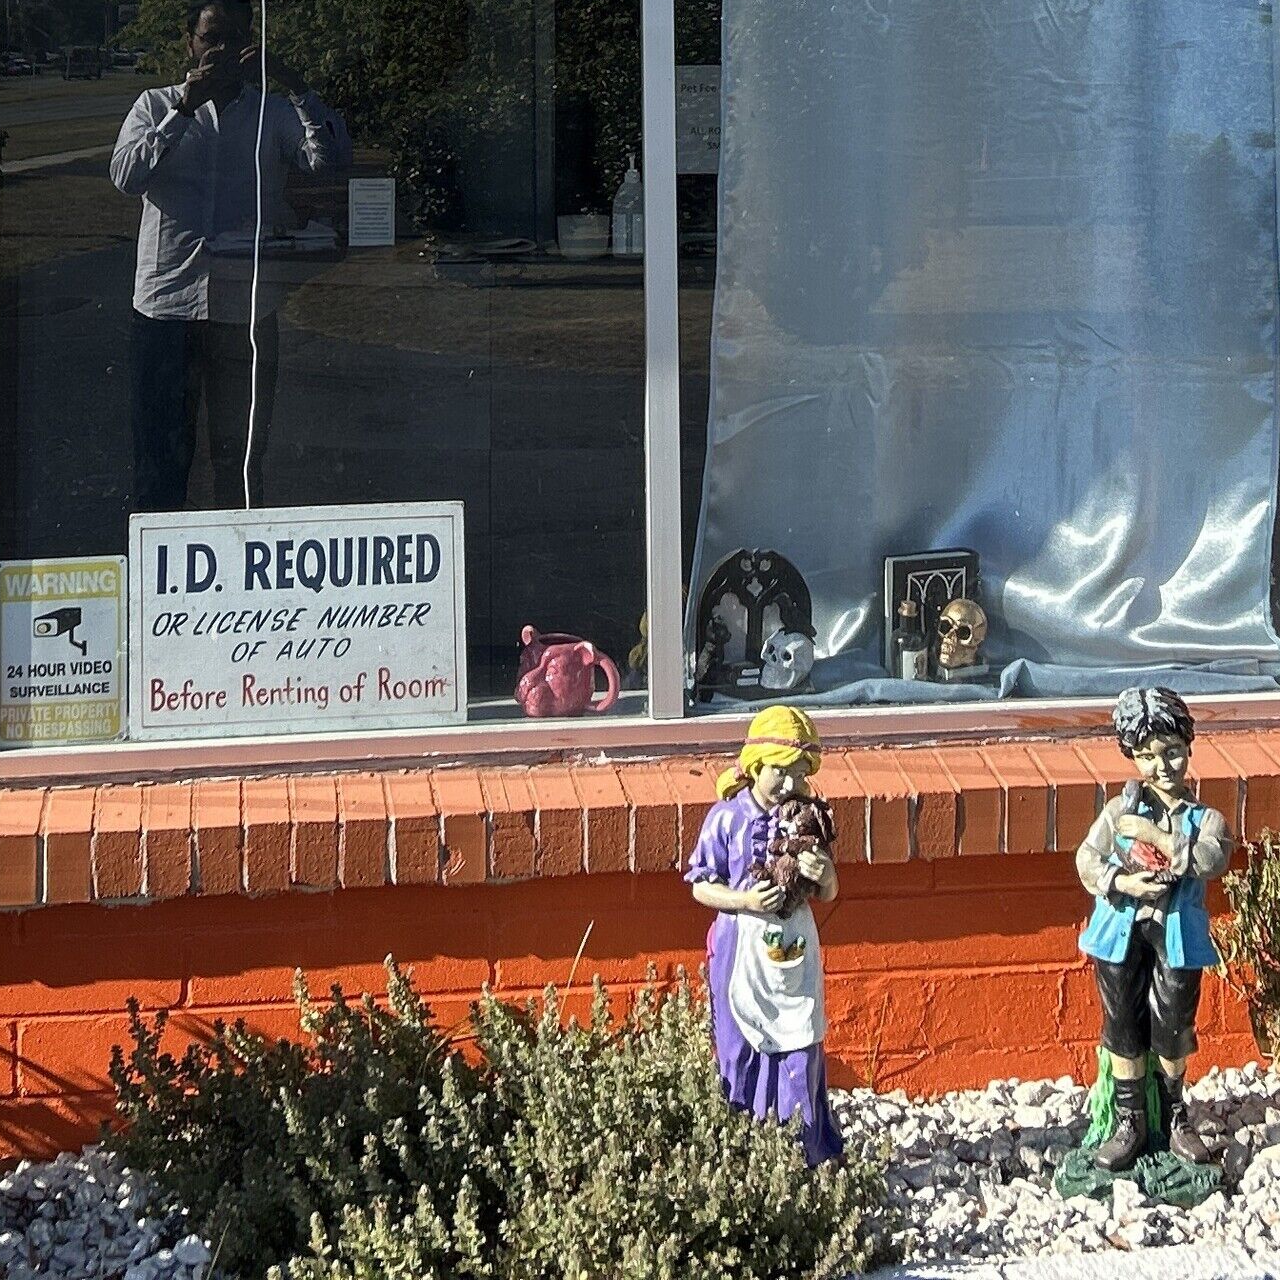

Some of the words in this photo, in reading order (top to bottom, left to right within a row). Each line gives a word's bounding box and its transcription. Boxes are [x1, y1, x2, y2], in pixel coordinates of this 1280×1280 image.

[156, 543, 223, 595] I.D.
[244, 533, 441, 593] REQUIRED
[4, 570, 116, 597] WARNING
[151, 612, 188, 637] OR
[192, 607, 307, 635] LICENSE
[317, 602, 432, 630] NUMBER
[230, 640, 267, 663] OF
[275, 637, 351, 662] AUTO
[7, 665, 23, 679] 24
[27, 662, 66, 677] HOUR
[70, 660, 112, 675] VIDEO
[9, 681, 110, 698] SURVEILLANCE
[150, 677, 227, 713] Before
[242, 673, 329, 710] Renting
[339, 671, 367, 703] of
[377, 666, 450, 702] Room
[1, 706, 52, 723] PRIVATE
[55, 702, 118, 720] PROPERTY
[6, 724, 24, 739] NO
[29, 718, 111, 738] TRESPASSING
